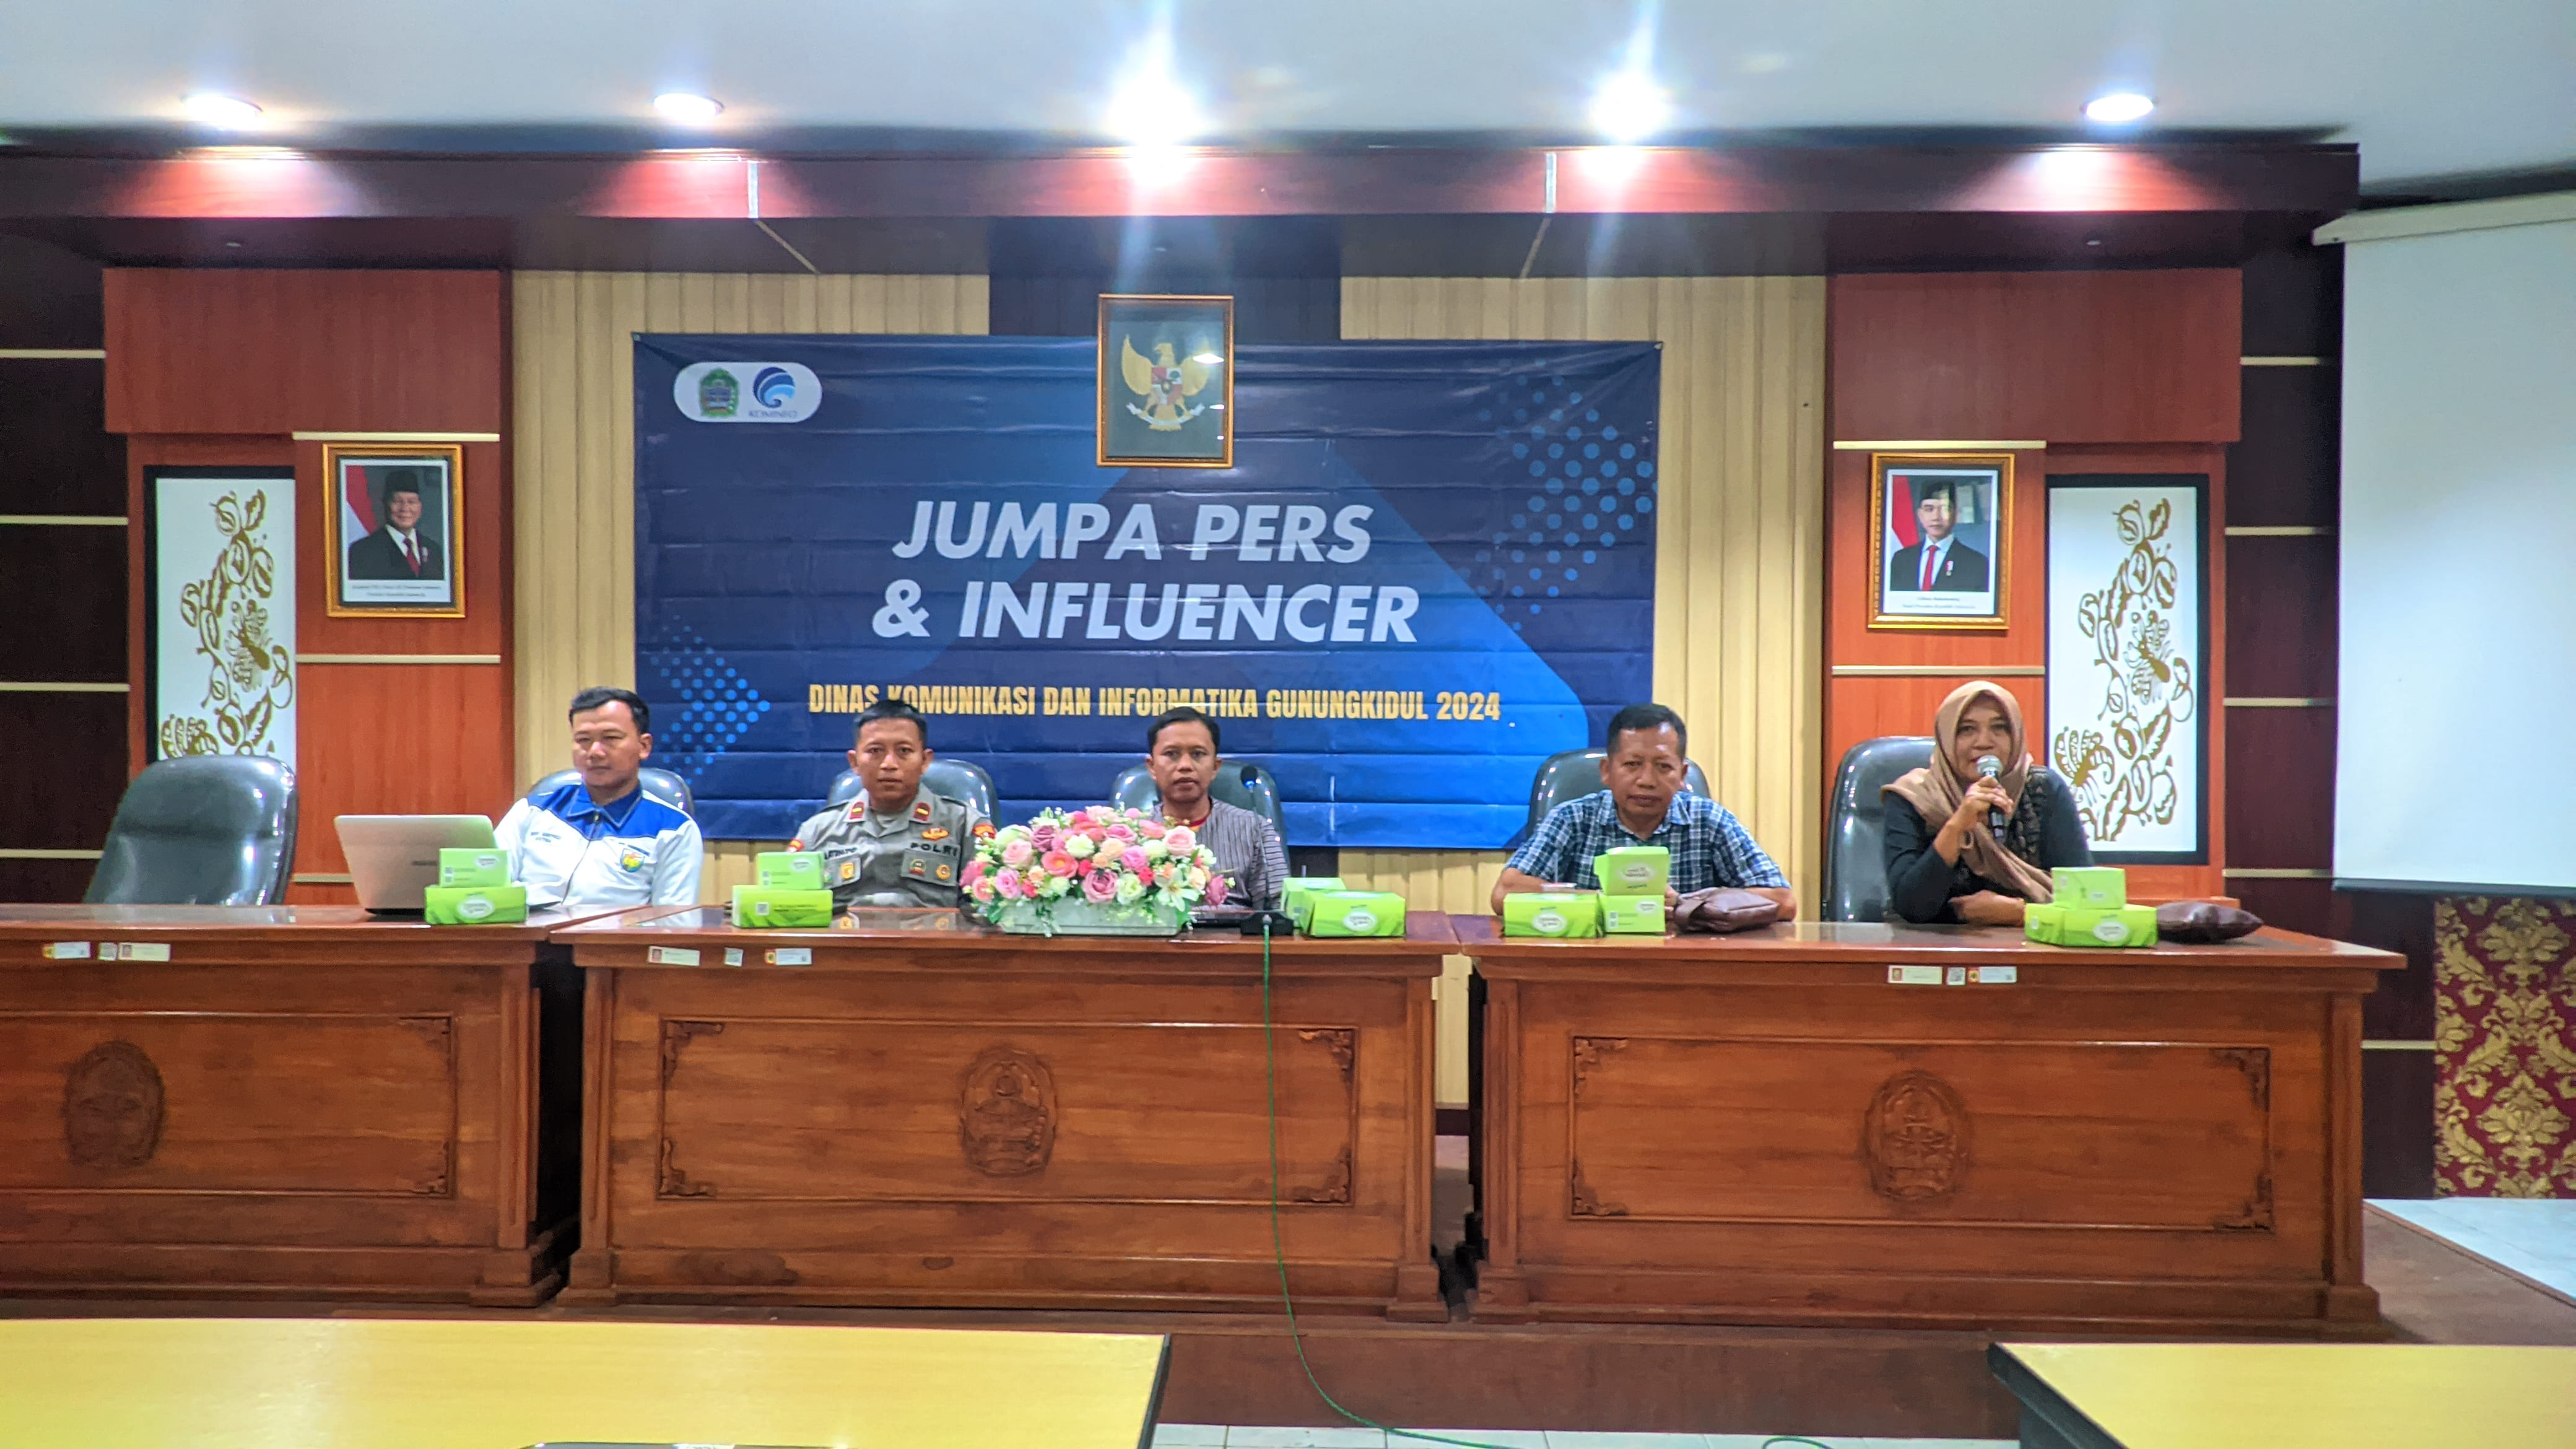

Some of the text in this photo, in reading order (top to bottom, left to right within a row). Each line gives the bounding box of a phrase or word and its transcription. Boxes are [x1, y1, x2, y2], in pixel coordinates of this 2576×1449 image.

[892, 501, 1374, 563] JUMPA PERS
[872, 579, 1420, 643] & INFLUENCER
[809, 684, 879, 713] DINAS
[1043, 687, 1091, 716] DAN
[1099, 687, 1258, 718] INFORMATIKA
[1265, 689, 1429, 720] GUNUNGKIDUL
[1437, 691, 1501, 721] 2024
[910, 842, 958, 856] POLRI
